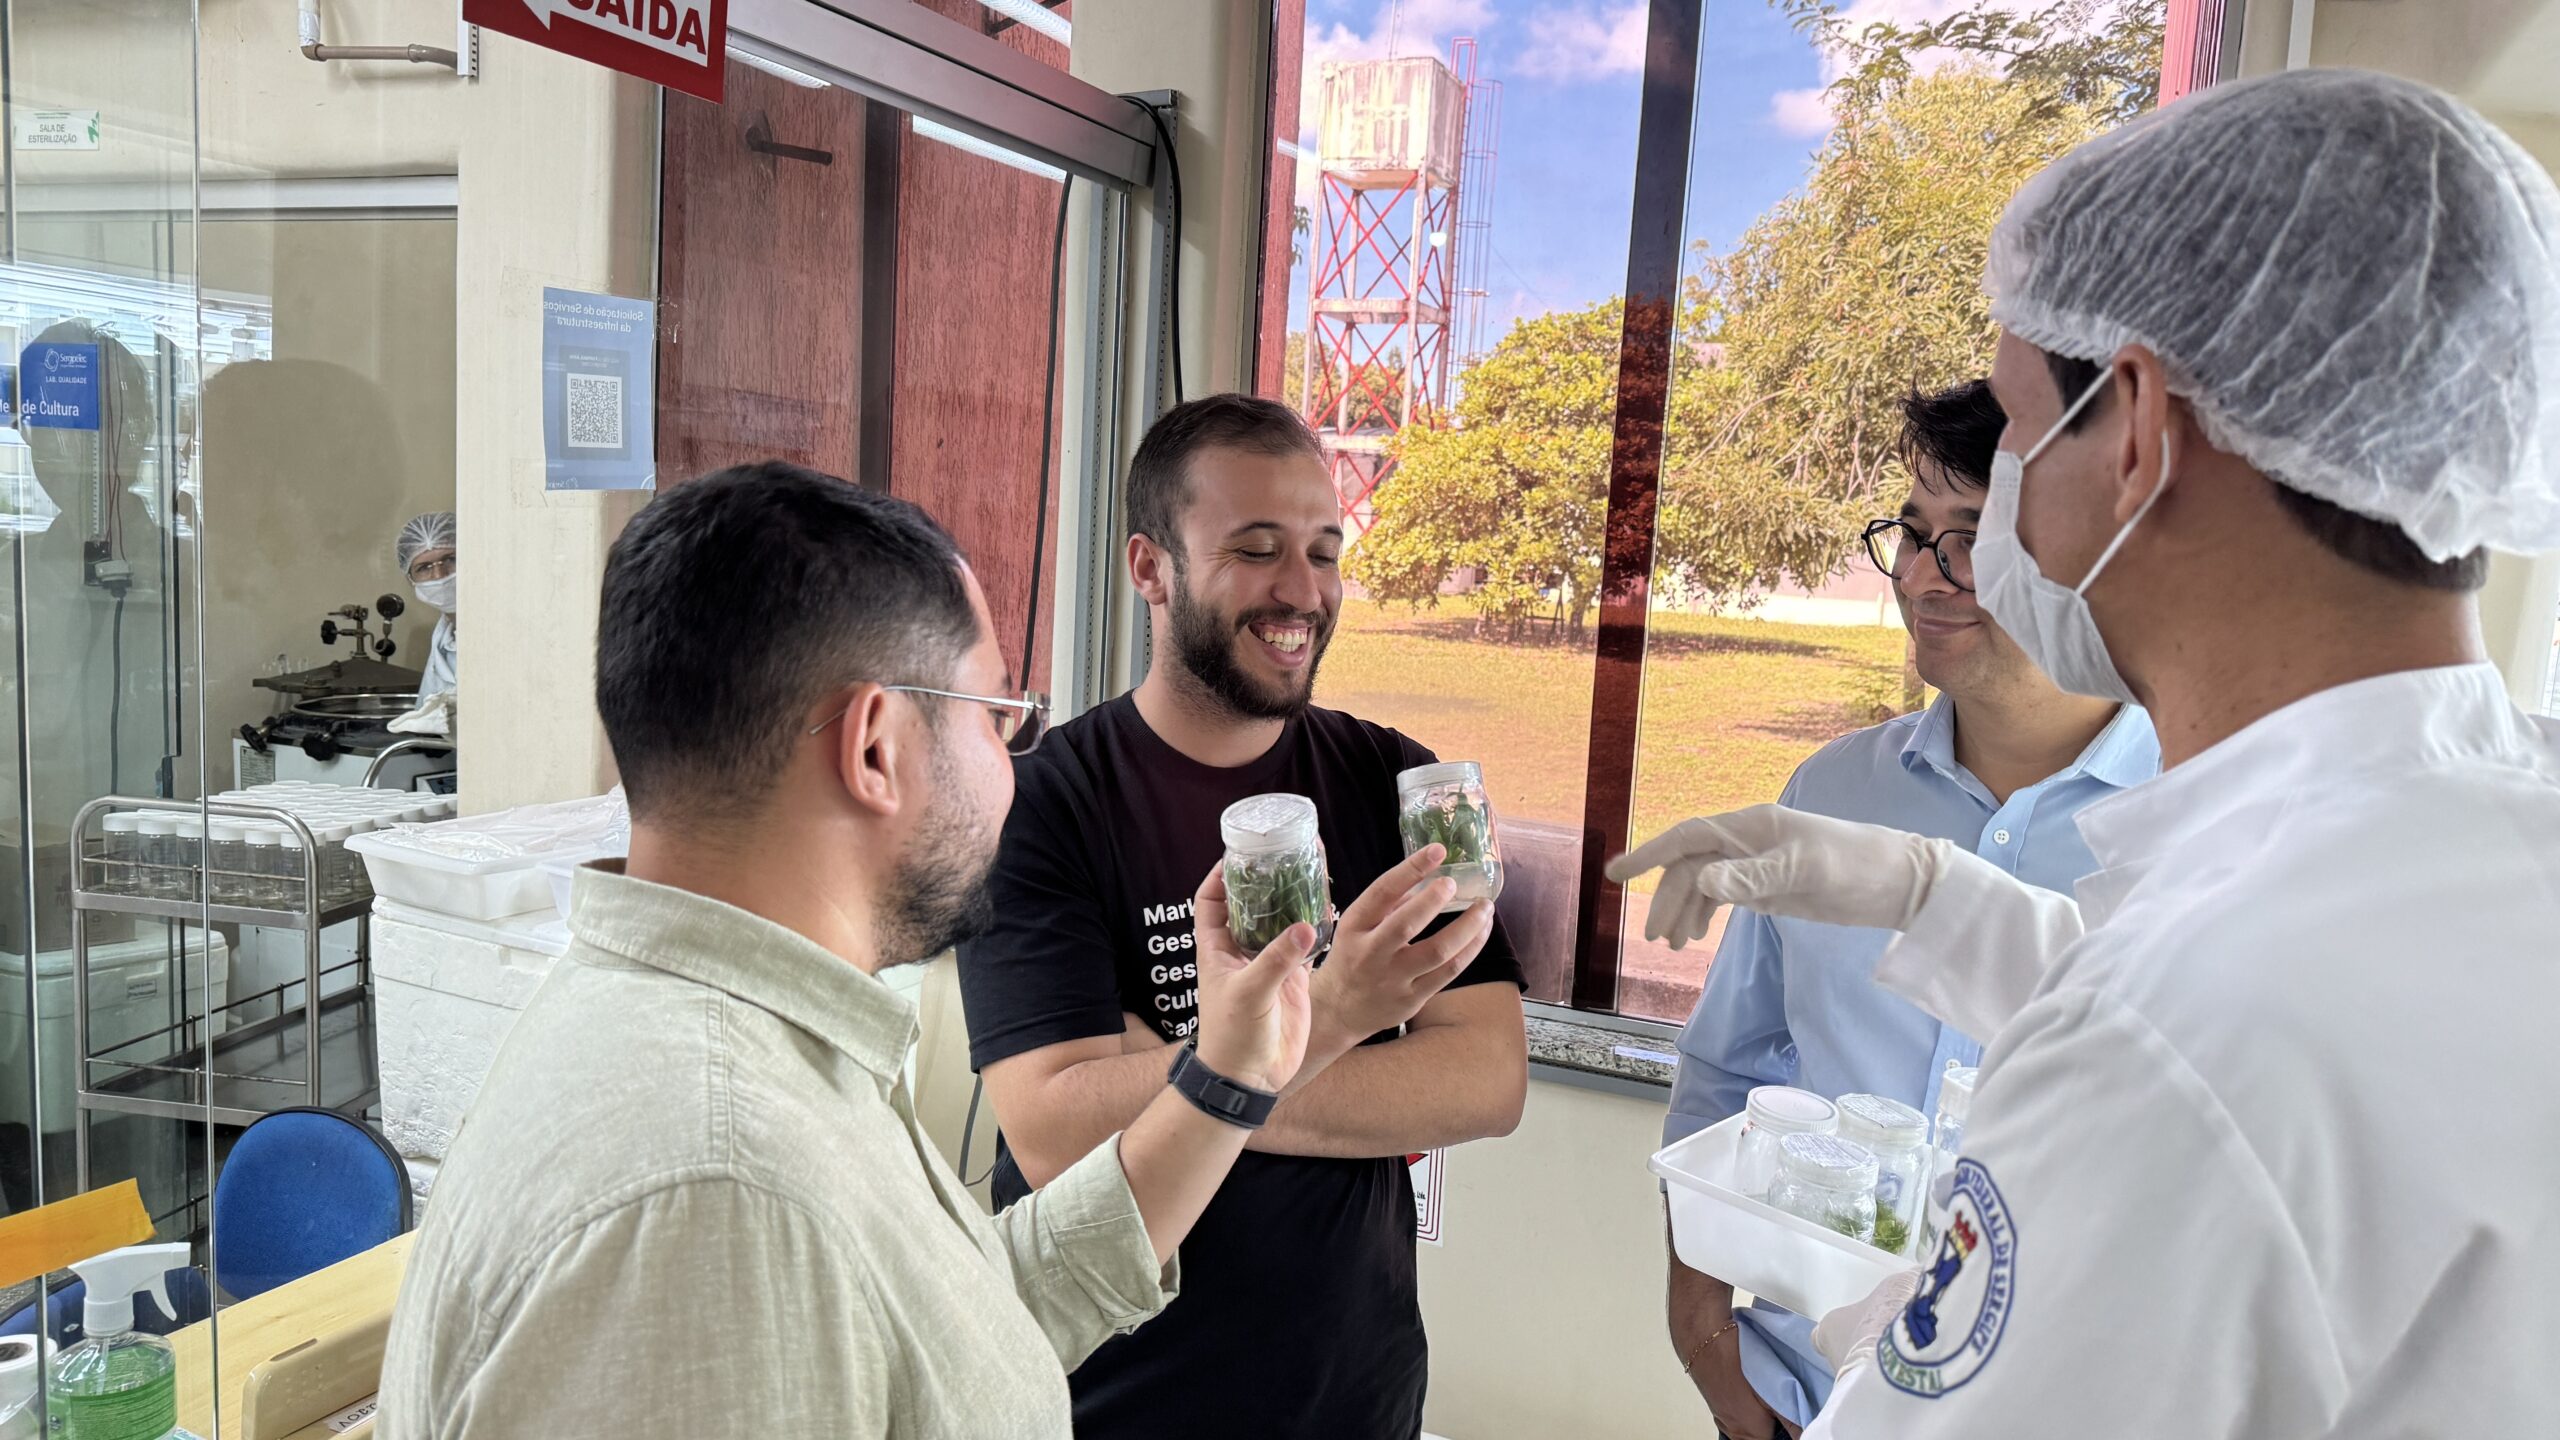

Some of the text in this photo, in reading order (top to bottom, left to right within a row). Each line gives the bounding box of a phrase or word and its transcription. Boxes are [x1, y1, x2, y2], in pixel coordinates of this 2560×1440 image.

[39, 123, 65, 132] SALA DE
[28, 133, 77, 144] ESTERILIZAÇÃO
[21, 399, 37, 414] de
[39, 400, 79, 416] Cultura
